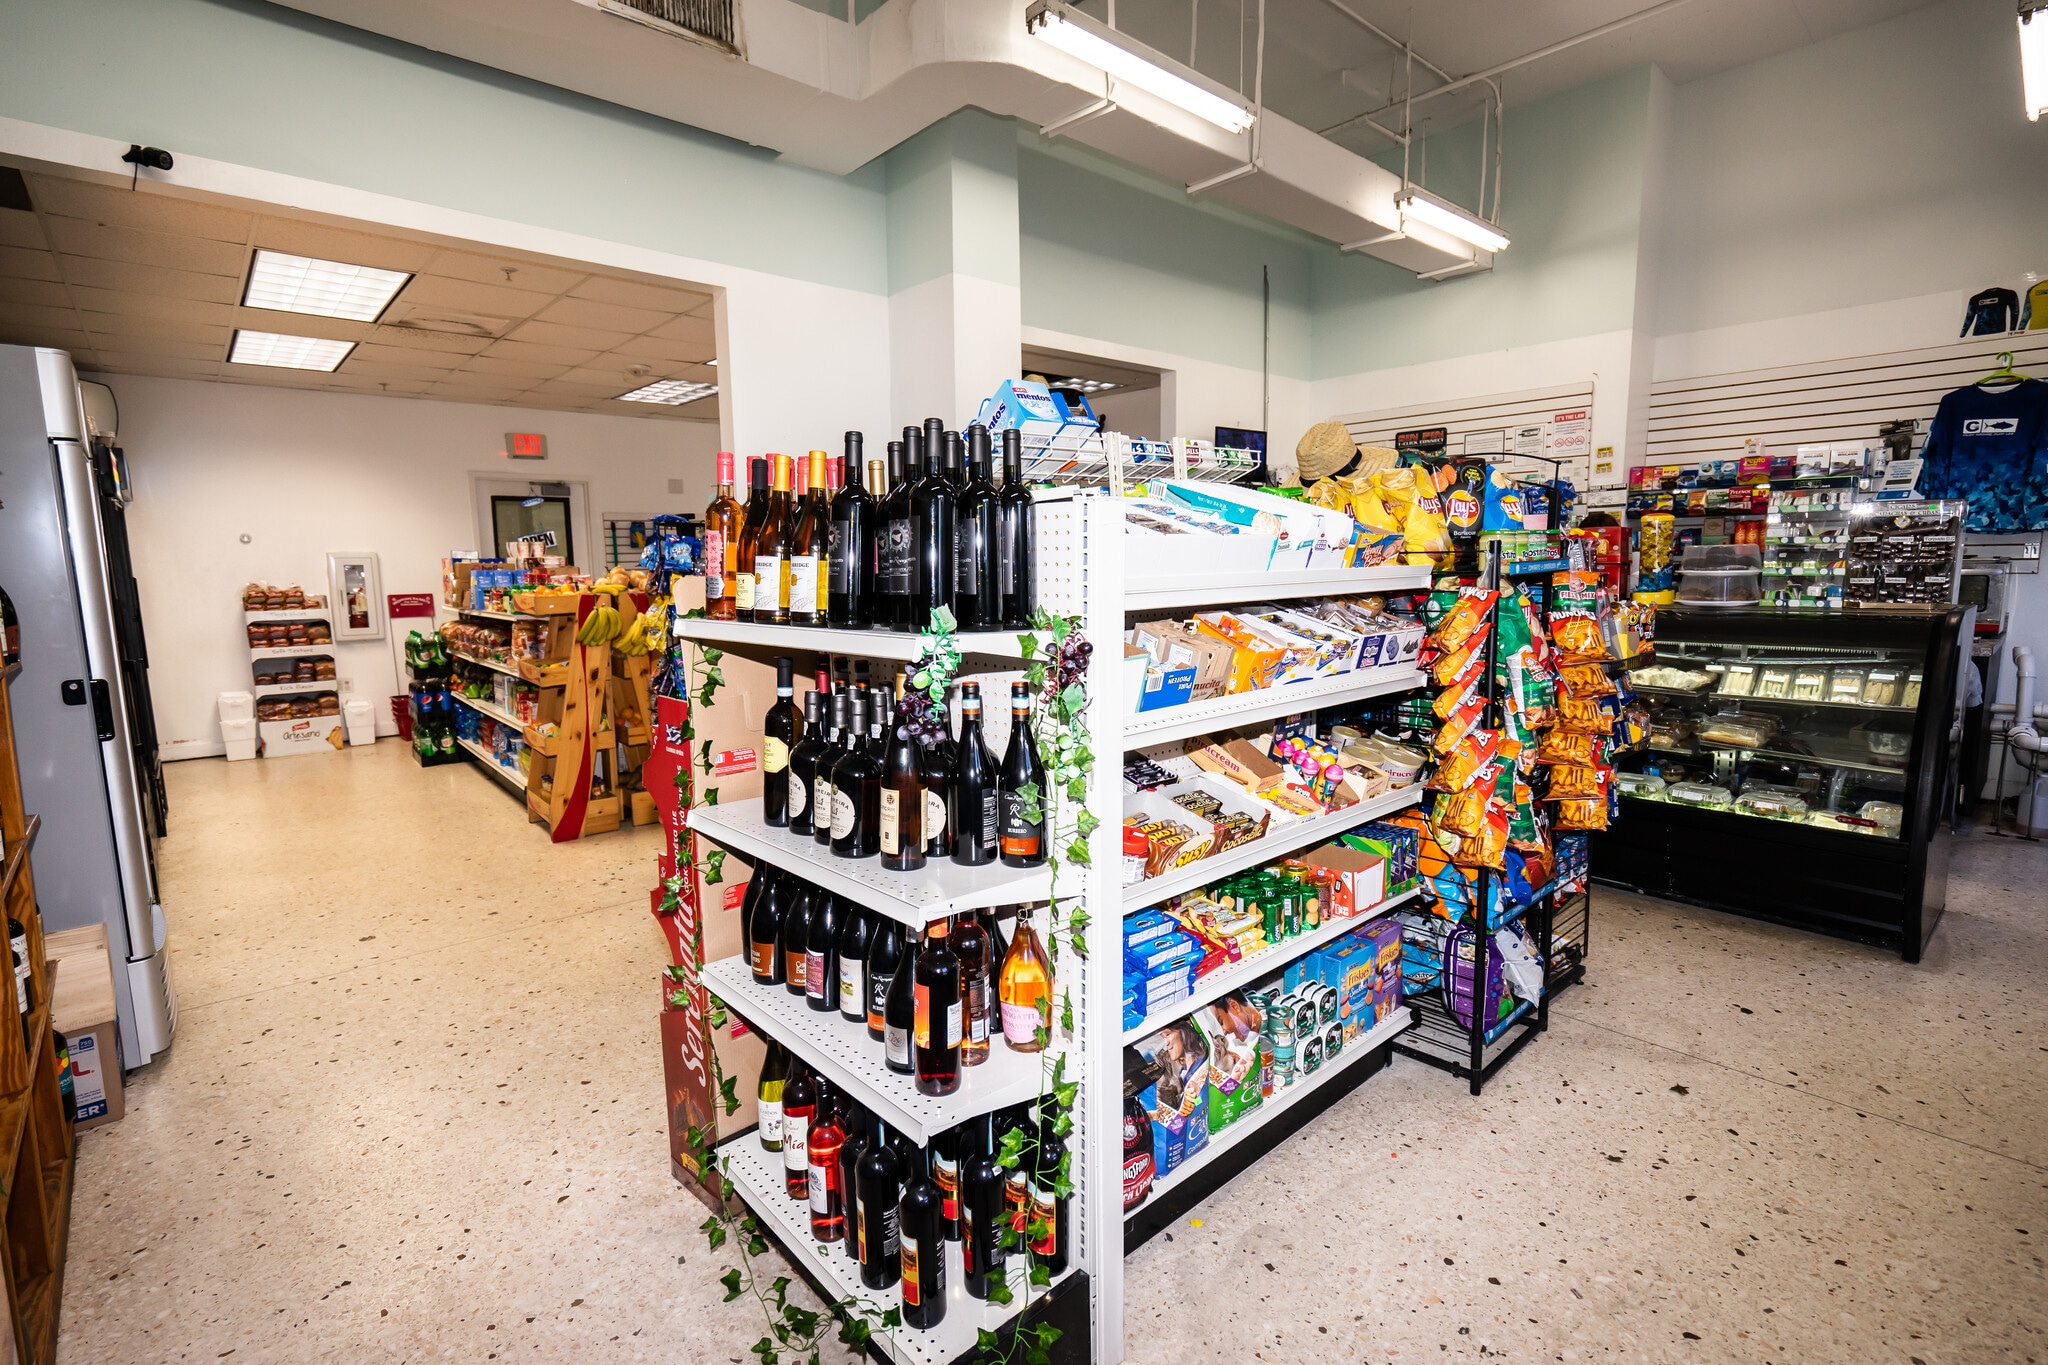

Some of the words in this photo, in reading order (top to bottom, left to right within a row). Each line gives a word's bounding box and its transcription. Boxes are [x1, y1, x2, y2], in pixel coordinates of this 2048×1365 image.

[1015, 392, 1051, 402] mentos
[986, 402, 1007, 433] ntos
[514, 434, 541, 455] EXIT
[1398, 432, 1418, 442] SIN
[1421, 430, 1445, 440] PIN
[1419, 437, 1444, 445] CONNECT
[1745, 457, 1766, 465] Pepto
[1450, 498, 1478, 518] Lay's
[1500, 498, 1521, 518] Lay
[522, 531, 555, 548] OPEN
[1167, 674, 1192, 685] PROTEIN
[1177, 682, 1193, 691] PURE
[283, 727, 321, 741] Artesano
[1191, 737, 1241, 773] pirucream
[1141, 821, 1163, 834] usy
[1164, 834, 1186, 846] usy
[1221, 823, 1264, 852] Cocosette
[1173, 840, 1211, 871] Susy
[1379, 946, 1399, 966] Friskies
[1347, 967, 1371, 987] Friskies
[80, 1038, 93, 1048] 750
[1123, 1156, 1149, 1181] NGSFORD
